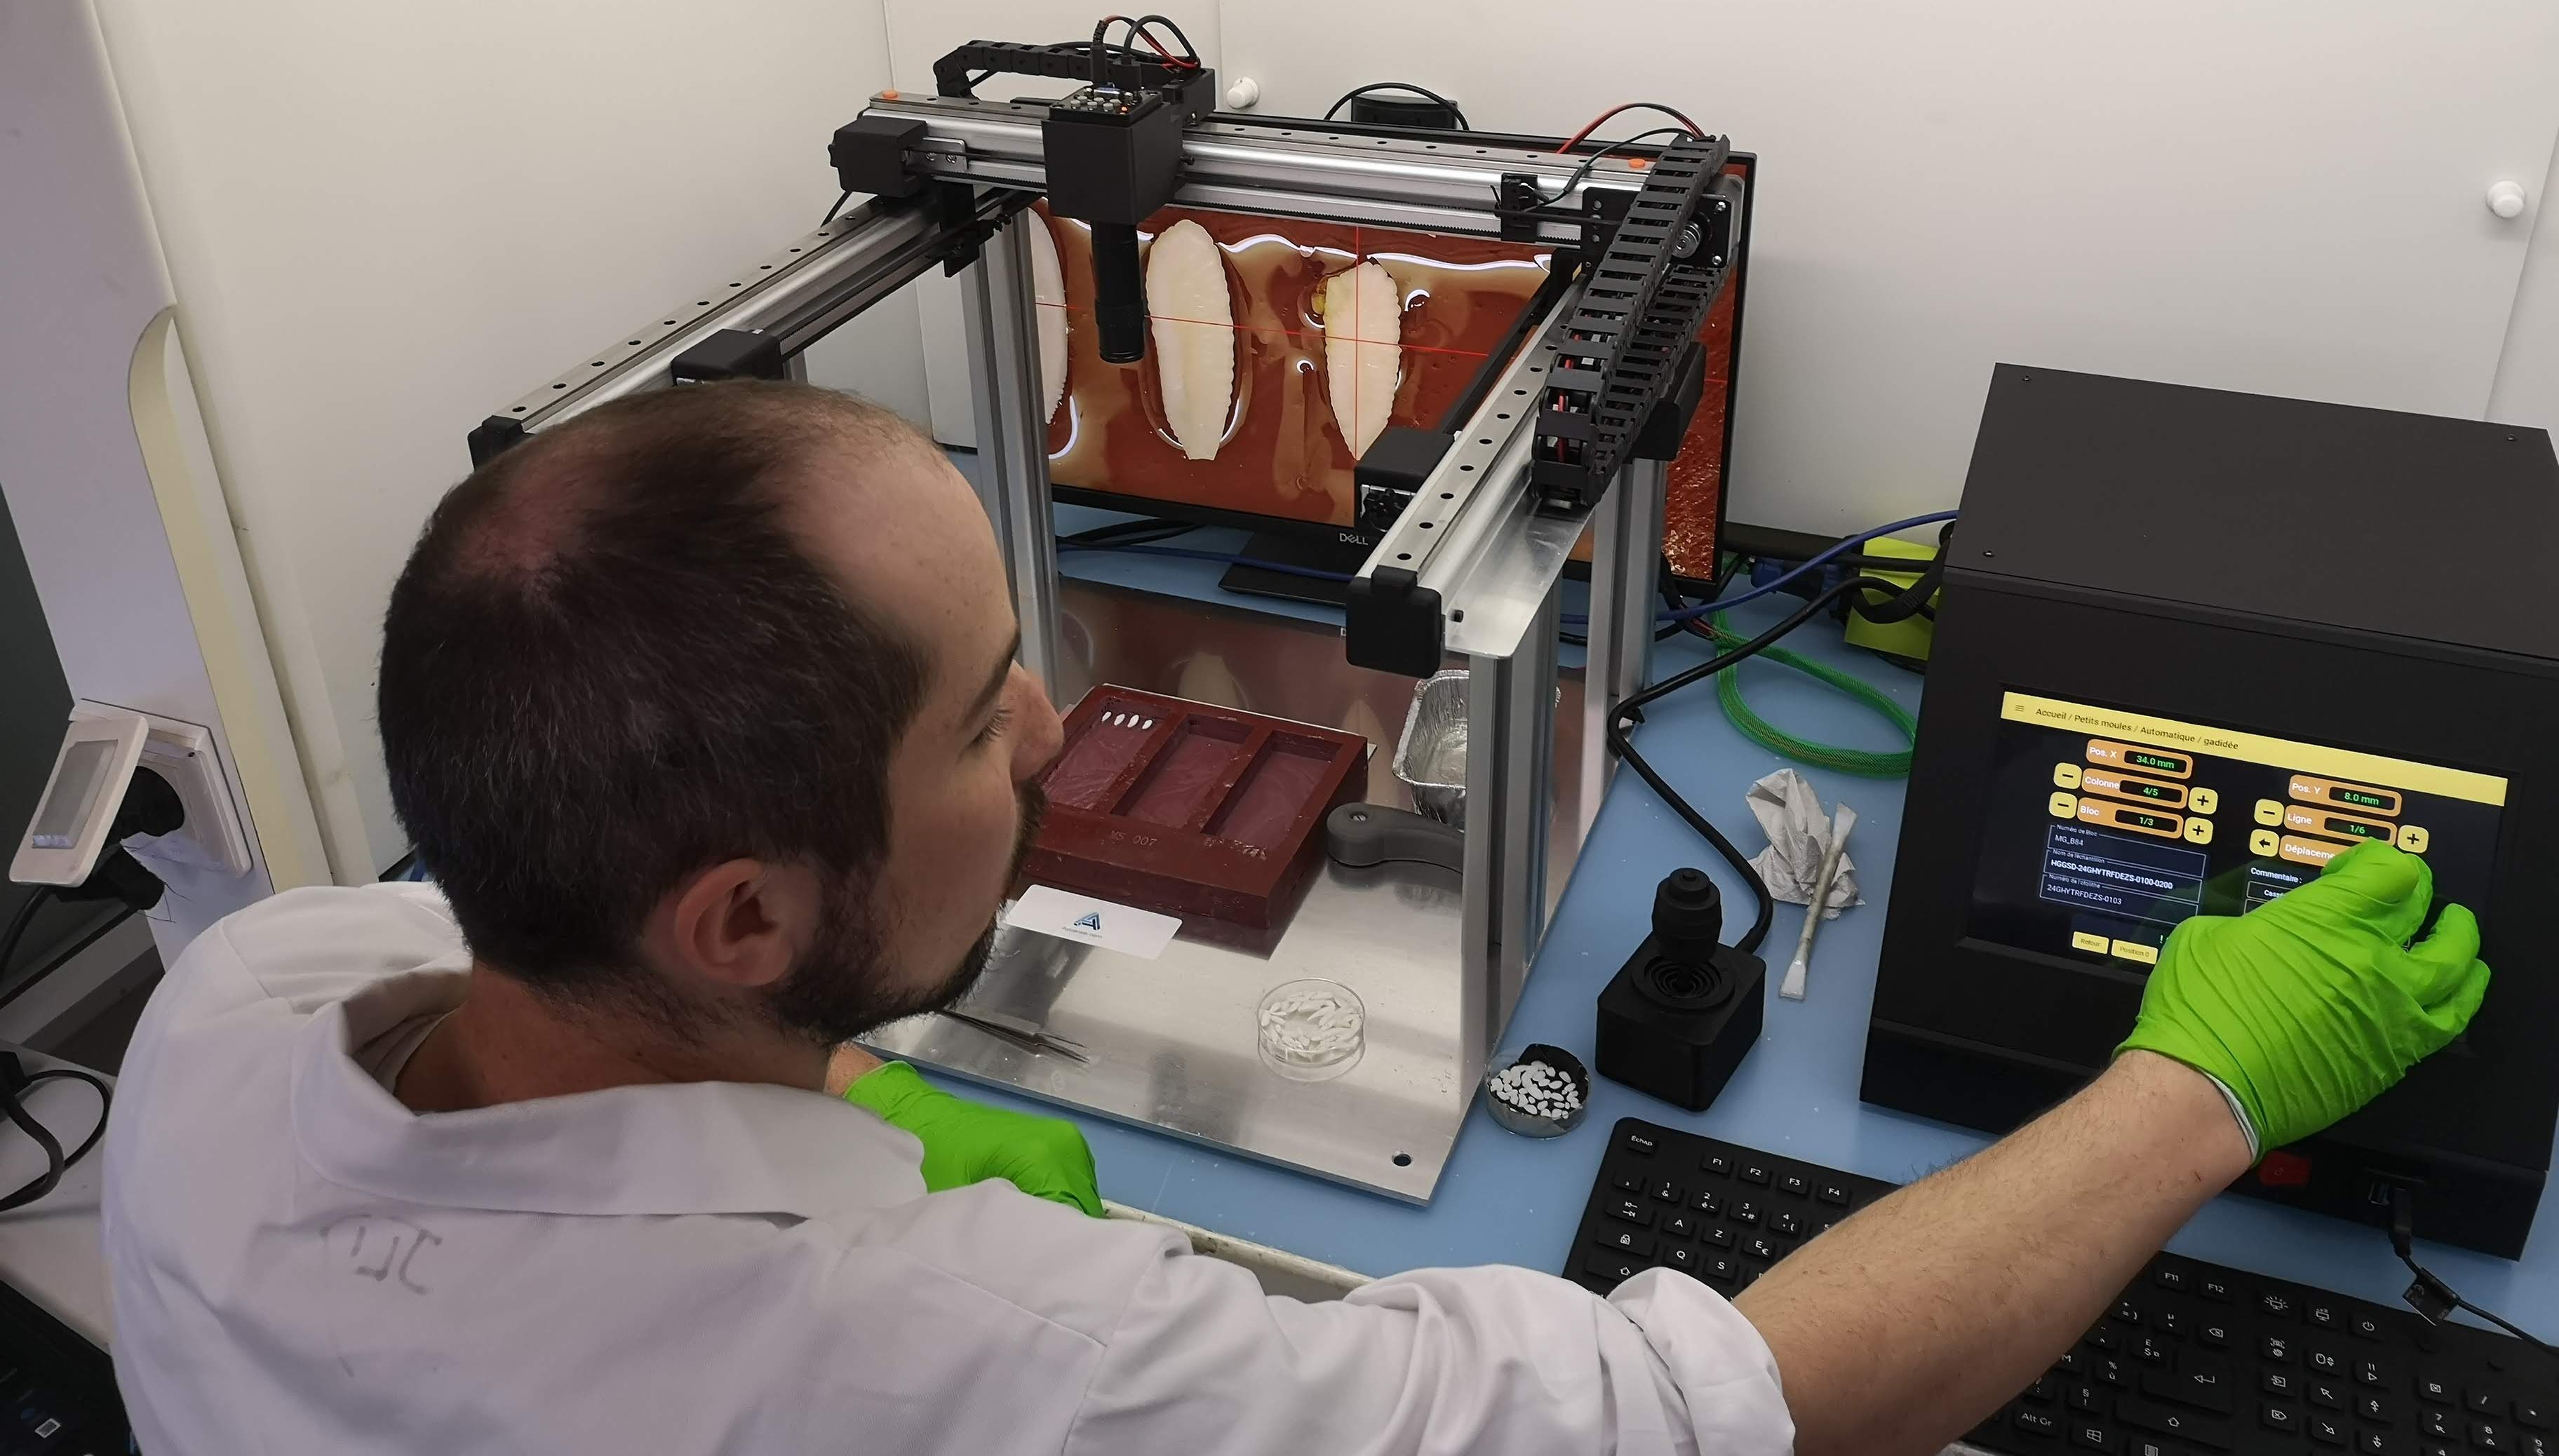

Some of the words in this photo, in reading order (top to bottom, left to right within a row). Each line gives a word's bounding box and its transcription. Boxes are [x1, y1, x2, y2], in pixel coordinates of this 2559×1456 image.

[1339, 533, 1369, 546] DELL
[2035, 708, 2067, 720] Accueil
[2074, 715, 2100, 726] Petits
[2101, 720, 2132, 732] moules
[2140, 726, 2196, 743] Automatique
[2203, 738, 2239, 750] gadidée
[2090, 746, 2108, 757] Pos.
[2110, 750, 2117, 759] X
[2136, 755, 2156, 767] 34.0
[2157, 760, 2175, 769] mm
[2085, 776, 2120, 790] Colonne
[2292, 782, 2311, 793] Pos.
[2314, 786, 2321, 795] Y
[2143, 786, 2158, 797] 4/5
[2344, 792, 2359, 802] 8.0
[2360, 797, 2379, 806] mm
[2080, 805, 2100, 816] Bloc
[2139, 816, 2154, 826] 1/3
[2287, 812, 2313, 825] Ligne
[2350, 824, 2365, 834] 1/6
[2055, 834, 2084, 846] MG_B84
[2285, 843, 2335, 859] Déplaceme
[2250, 867, 2299, 883] Commentaire
[2047, 884, 2122, 905] 24GHYTRFDEZS-0103
[2081, 938, 2101, 948] Retour
[2120, 946, 2144, 957] Position
[1631, 1135, 1653, 1147] Échap
[1750, 1168, 1761, 1176] F2
[1789, 1178, 1801, 1186] F3
[1829, 1187, 1840, 1197] F4
[1674, 1219, 1683, 1227] A
[1715, 1229, 1724, 1238] Z
[1755, 1240, 1764, 1248] E
[1677, 1251, 1686, 1260] Q
[1717, 1262, 1726, 1270] S
[2165, 1272, 2179, 1282] F11
[2208, 1283, 2224, 1294] F12
[2062, 1354, 2071, 1363] M
[2022, 1413, 2036, 1423] Alt
[2039, 1417, 2053, 1427] Gr
[2485, 1426, 2493, 1434] 8
